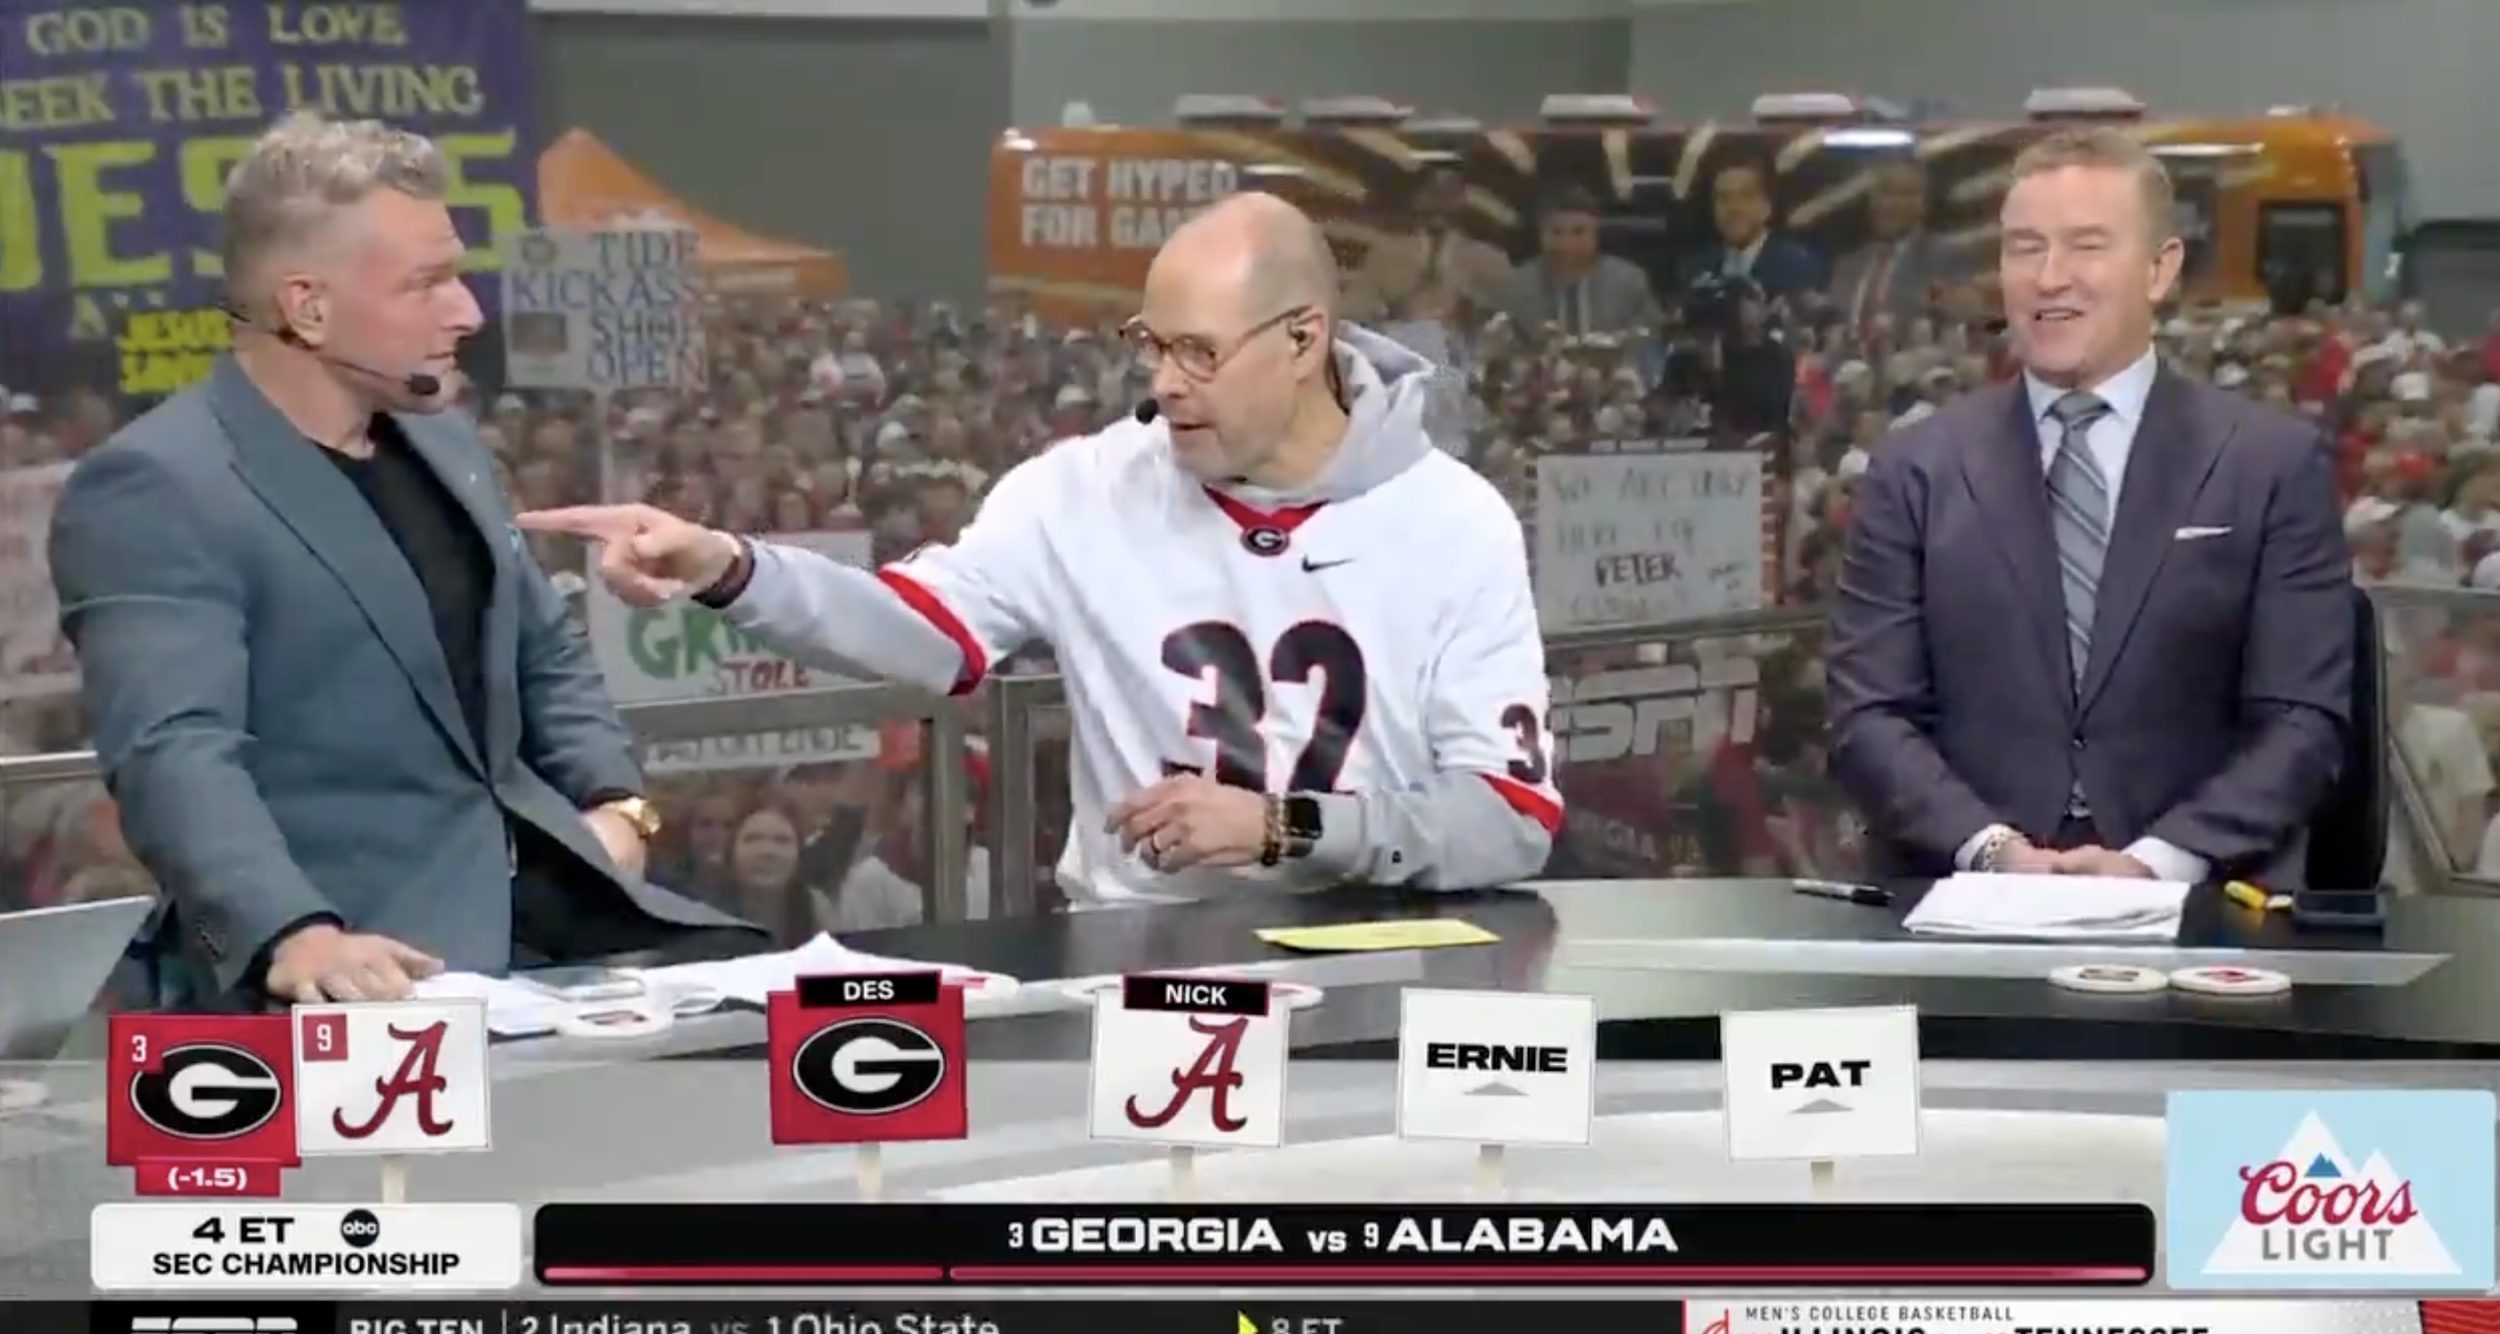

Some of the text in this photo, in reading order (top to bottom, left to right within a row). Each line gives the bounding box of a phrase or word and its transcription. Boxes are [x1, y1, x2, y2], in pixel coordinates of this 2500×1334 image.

[26, 4, 408, 55] GOD IS LOVE
[135, 66, 262, 122] THE
[1022, 158, 1238, 201] GET HYPED
[1022, 205, 1097, 248] FOR
[1595, 552, 1684, 588] PETER
[708, 659, 812, 694] STOLE
[1161, 620, 1367, 795] 32
